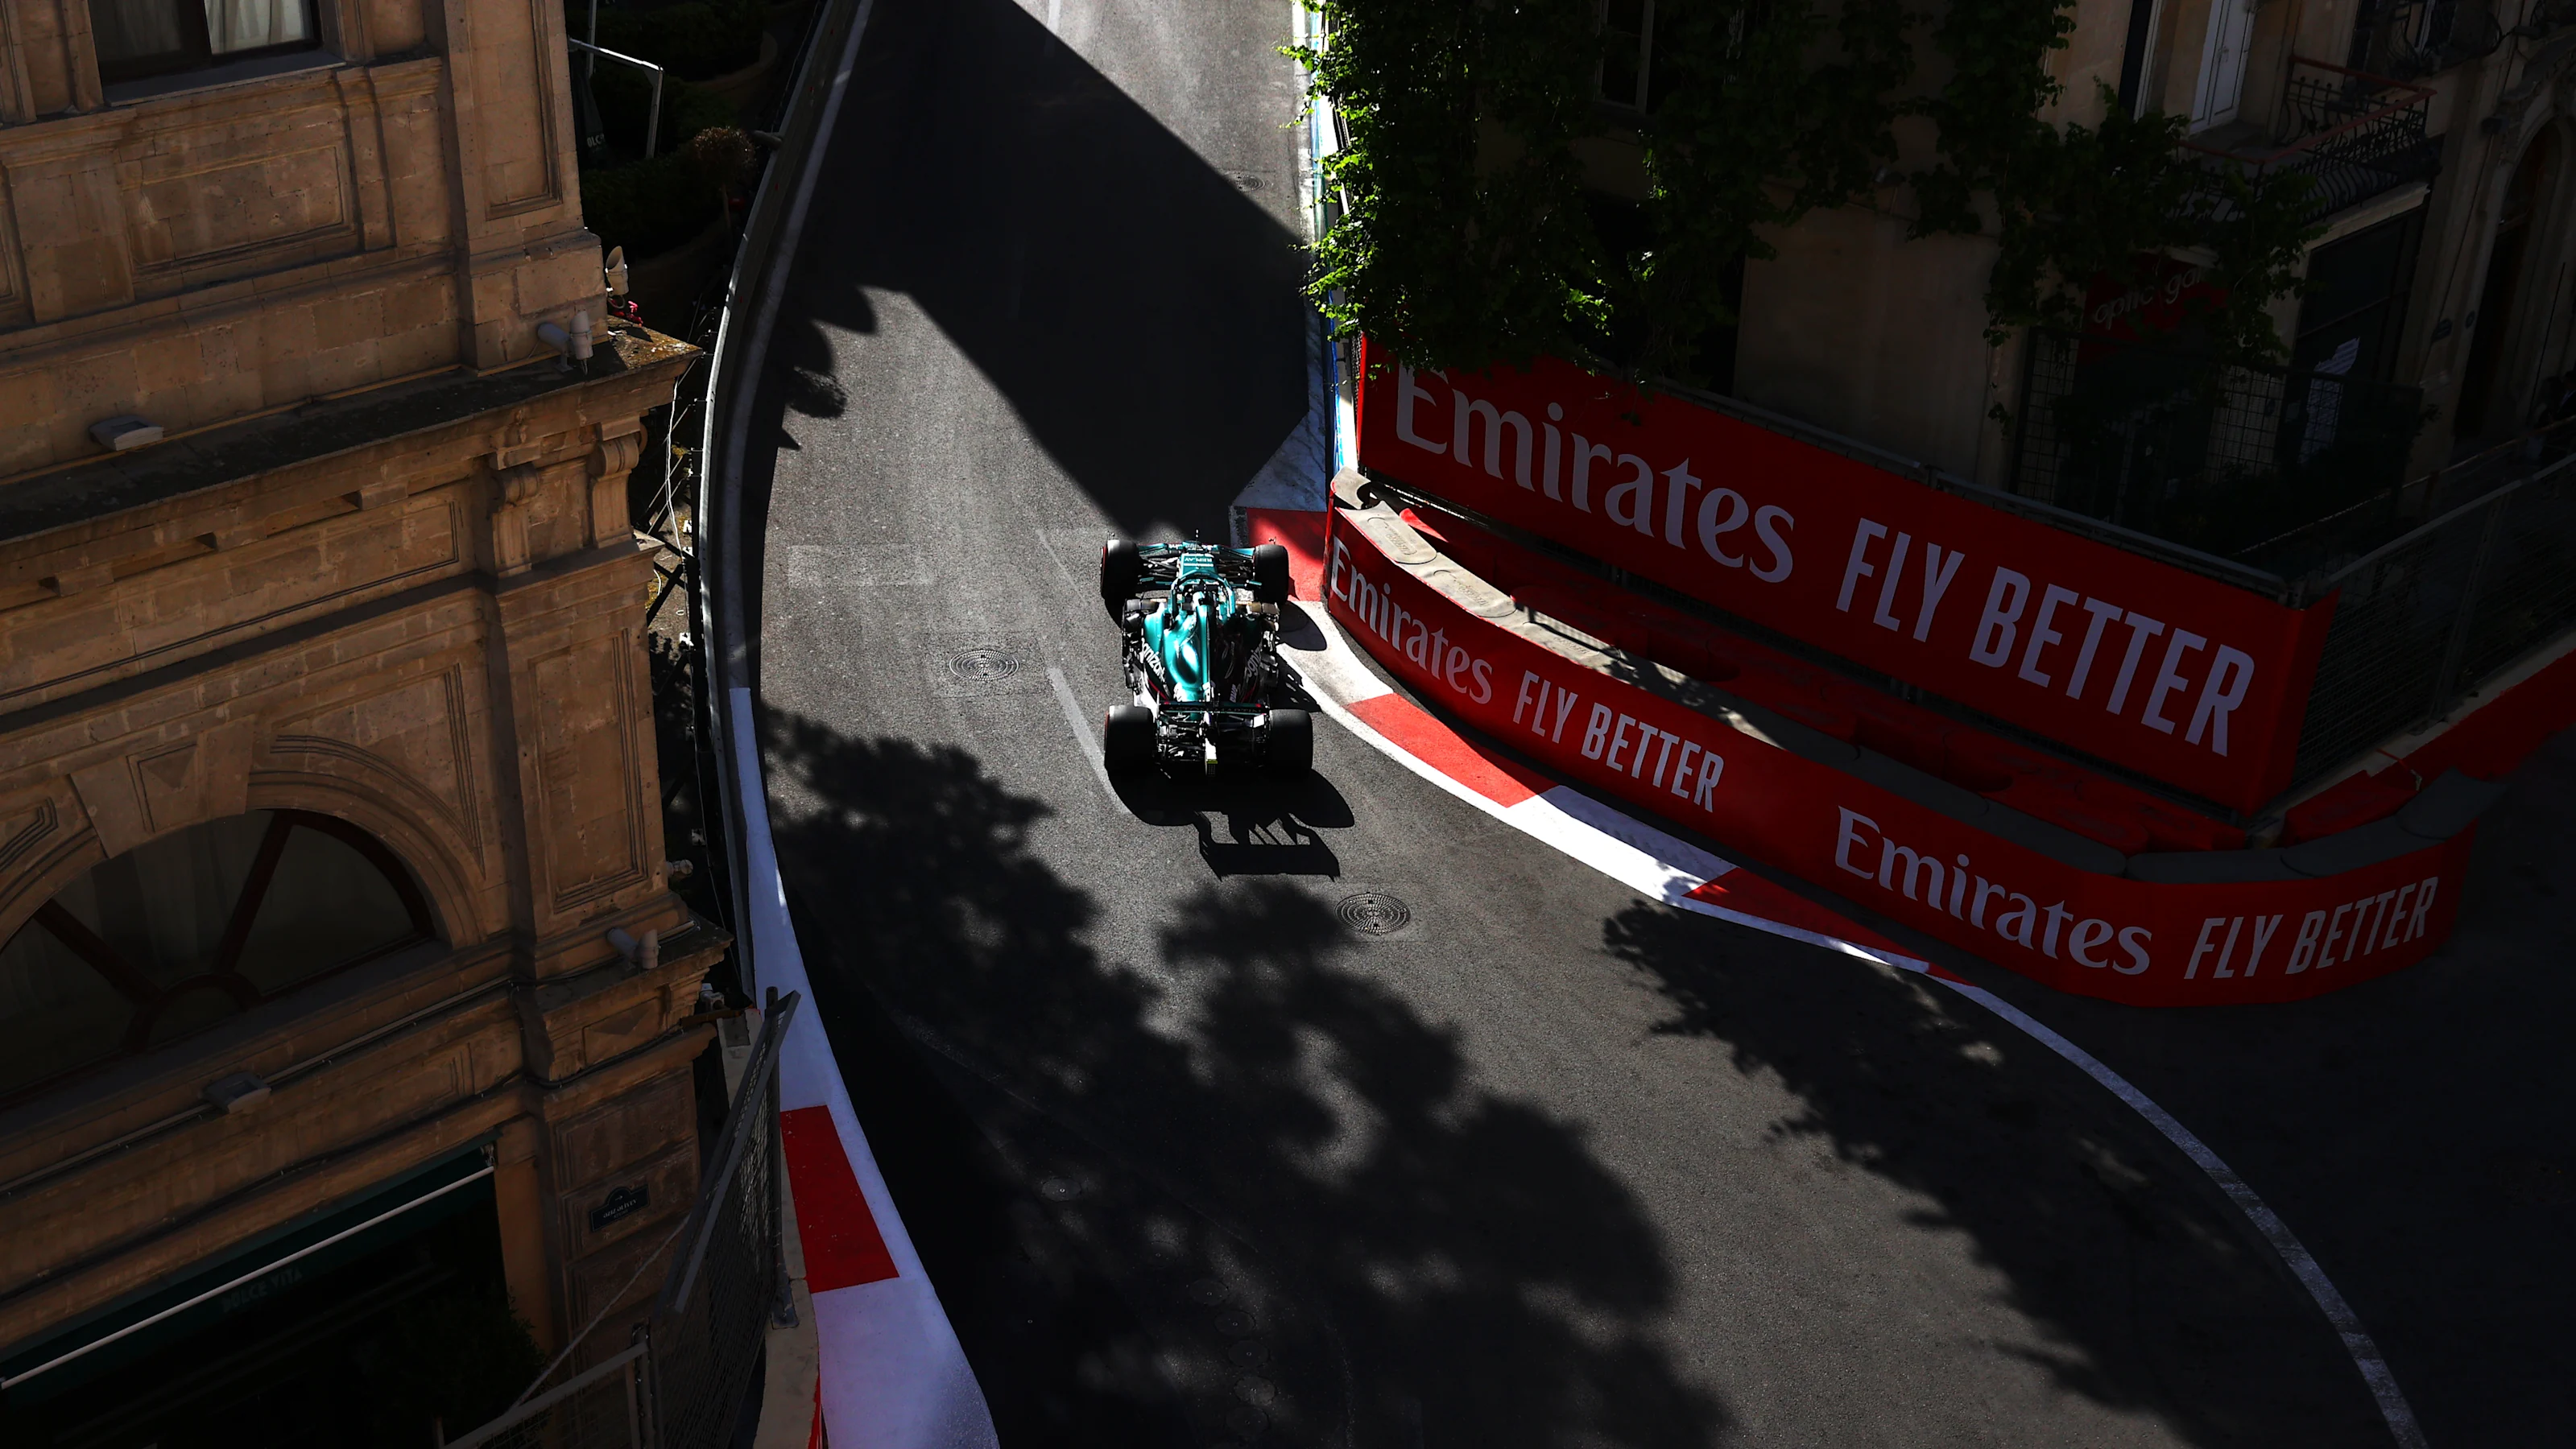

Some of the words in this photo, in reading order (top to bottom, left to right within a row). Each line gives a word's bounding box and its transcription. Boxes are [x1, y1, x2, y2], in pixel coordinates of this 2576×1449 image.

[1329, 535, 1493, 704] Emirates
[1512, 671, 1579, 745] FLY
[1581, 702, 1726, 813] BETTER
[1396, 361, 1795, 586] Emirates
[1837, 518, 1966, 642] FLY
[1968, 565, 2255, 757] BETTER
[1834, 807, 2153, 976] Emirates
[2184, 916, 2284, 980] FLY
[2288, 877, 2438, 974] BETTER
